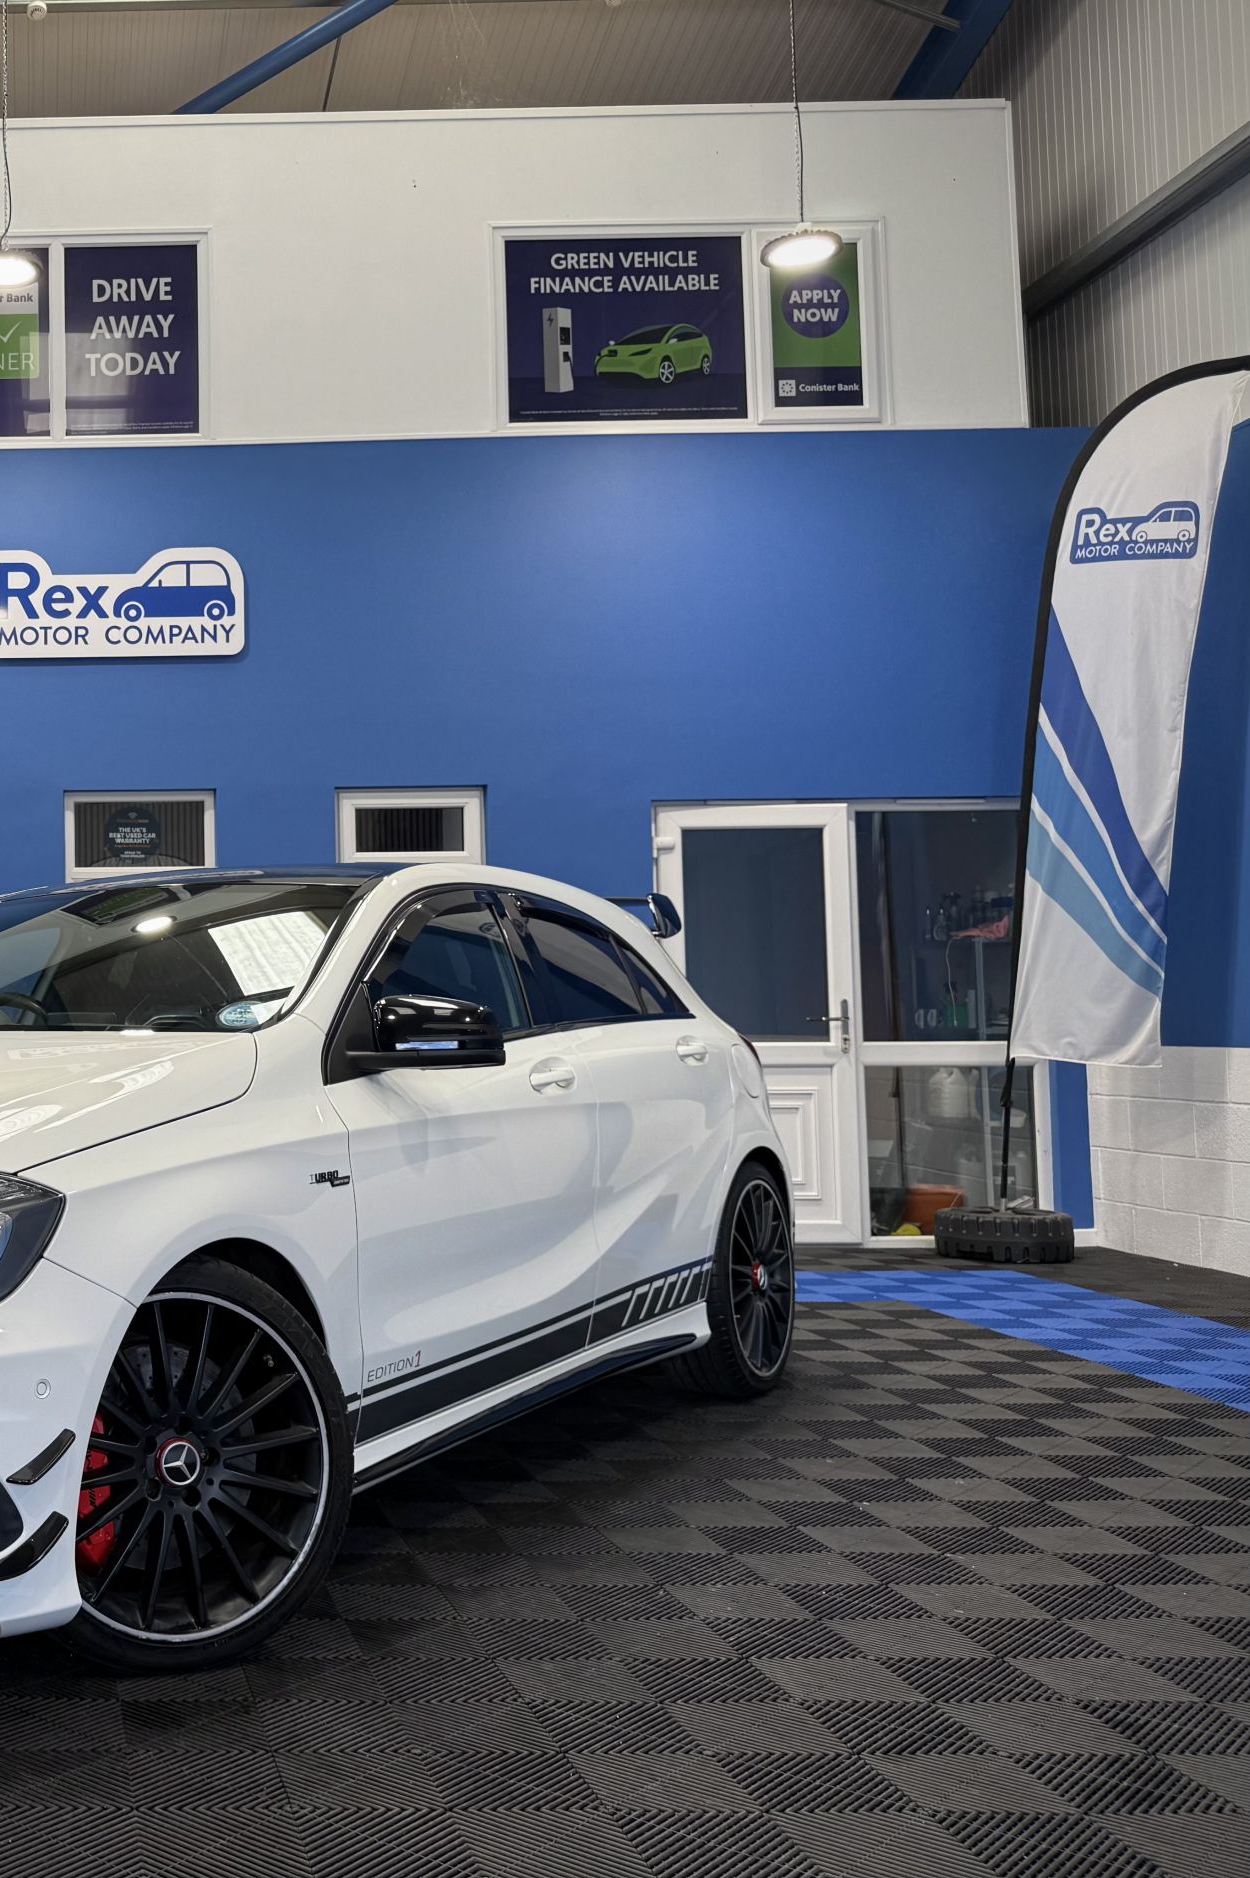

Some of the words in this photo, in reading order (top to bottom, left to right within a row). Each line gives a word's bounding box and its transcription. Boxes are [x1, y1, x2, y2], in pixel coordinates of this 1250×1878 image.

[550, 252, 614, 270] GREEN
[618, 250, 698, 269] VEHICLE
[92, 277, 172, 303] DRIVE
[530, 275, 613, 294] FINANCE
[618, 273, 719, 292] AVAILABLE
[6, 293, 34, 303] Bank
[788, 289, 841, 304] APPLY
[792, 307, 840, 322] NOW
[90, 313, 175, 339] AWAY
[85, 351, 181, 377] TODAY
[798, 382, 835, 393] Conister
[837, 382, 860, 392] Bank
[1077, 513, 1133, 546] Rex
[1075, 544, 1119, 559] MOTOR
[1125, 541, 1194, 555] COMPANY
[104, 624, 236, 645] COMPANY
